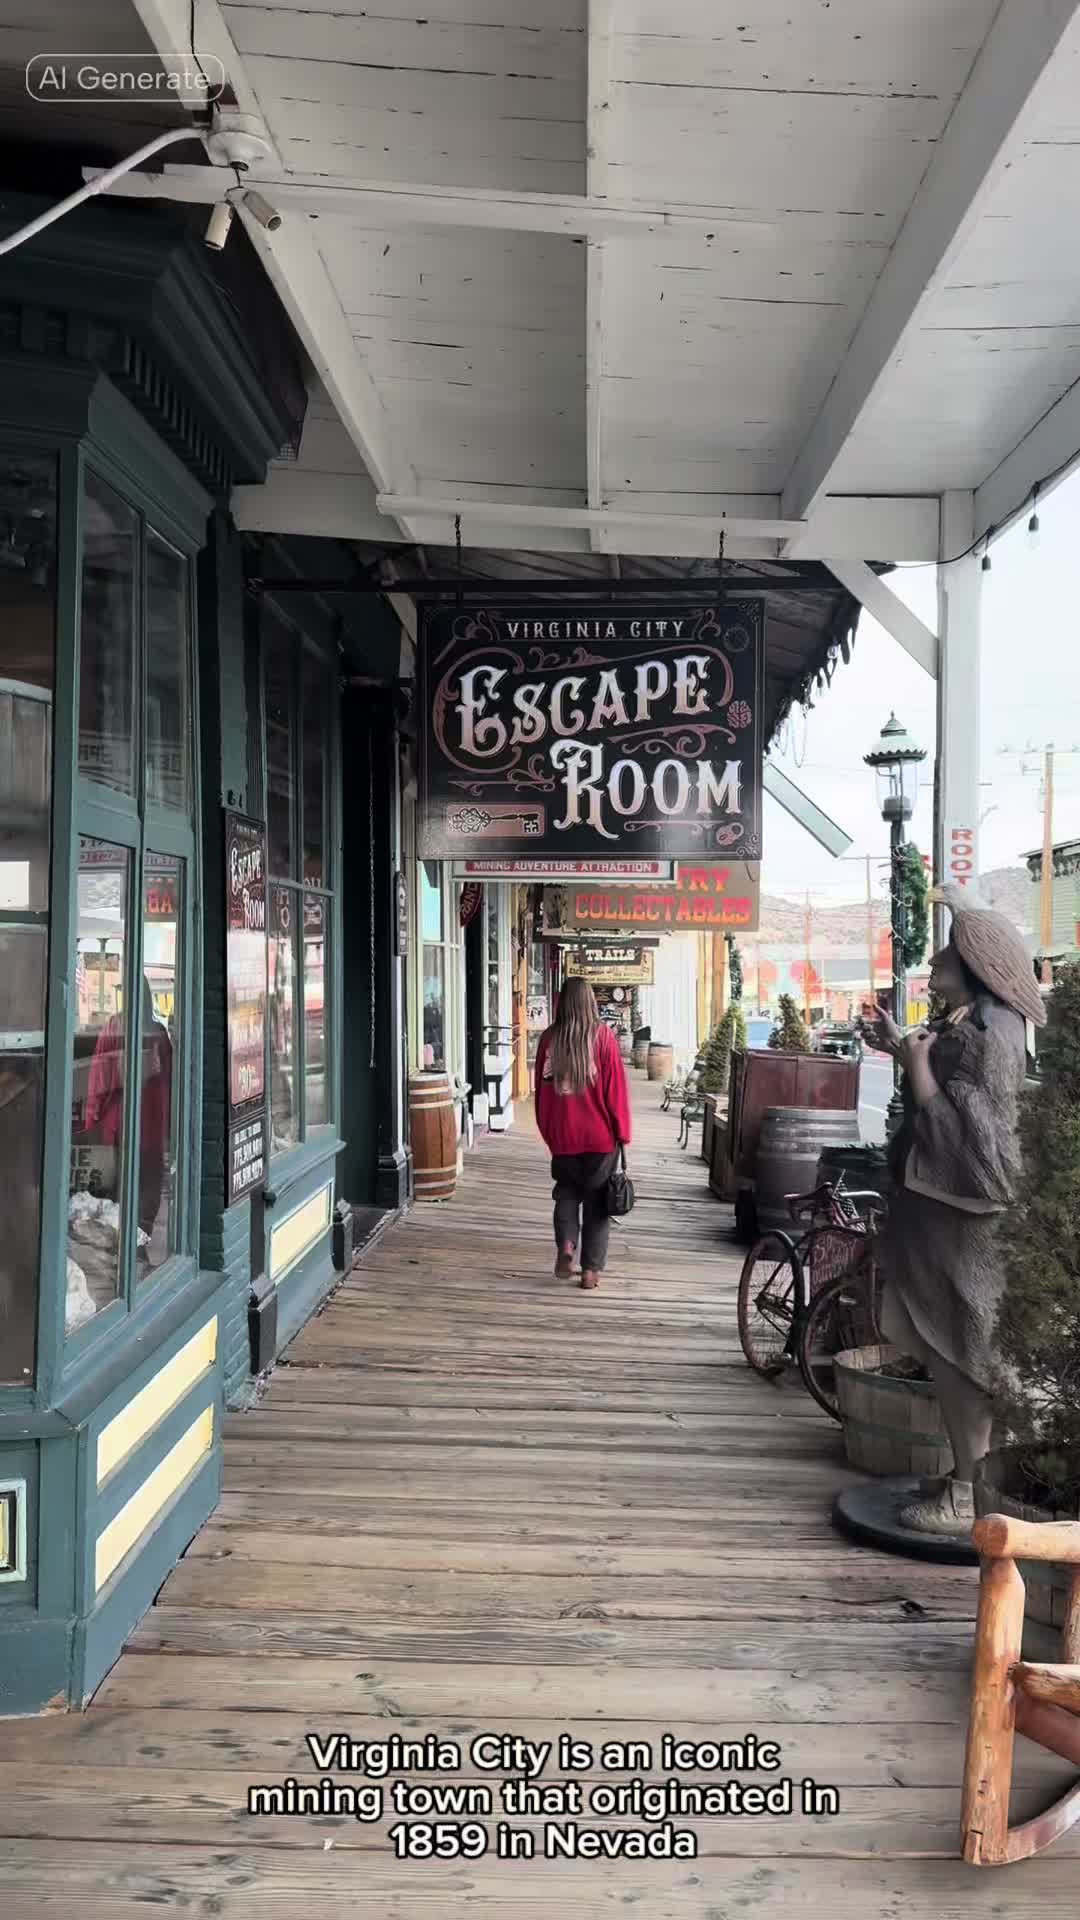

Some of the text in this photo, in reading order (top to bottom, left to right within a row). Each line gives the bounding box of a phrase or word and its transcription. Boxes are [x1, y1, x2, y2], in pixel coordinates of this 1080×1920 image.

[507, 621, 684, 638] VIRGINIA CITY
[455, 654, 712, 758] ESCAPE
[549, 738, 742, 840] ROOM
[474, 862, 652, 873] MINING ADVENTURE ATTRACTION
[575, 894, 753, 924] COLLECTABLES
[585, 948, 636, 961] TRAILS
